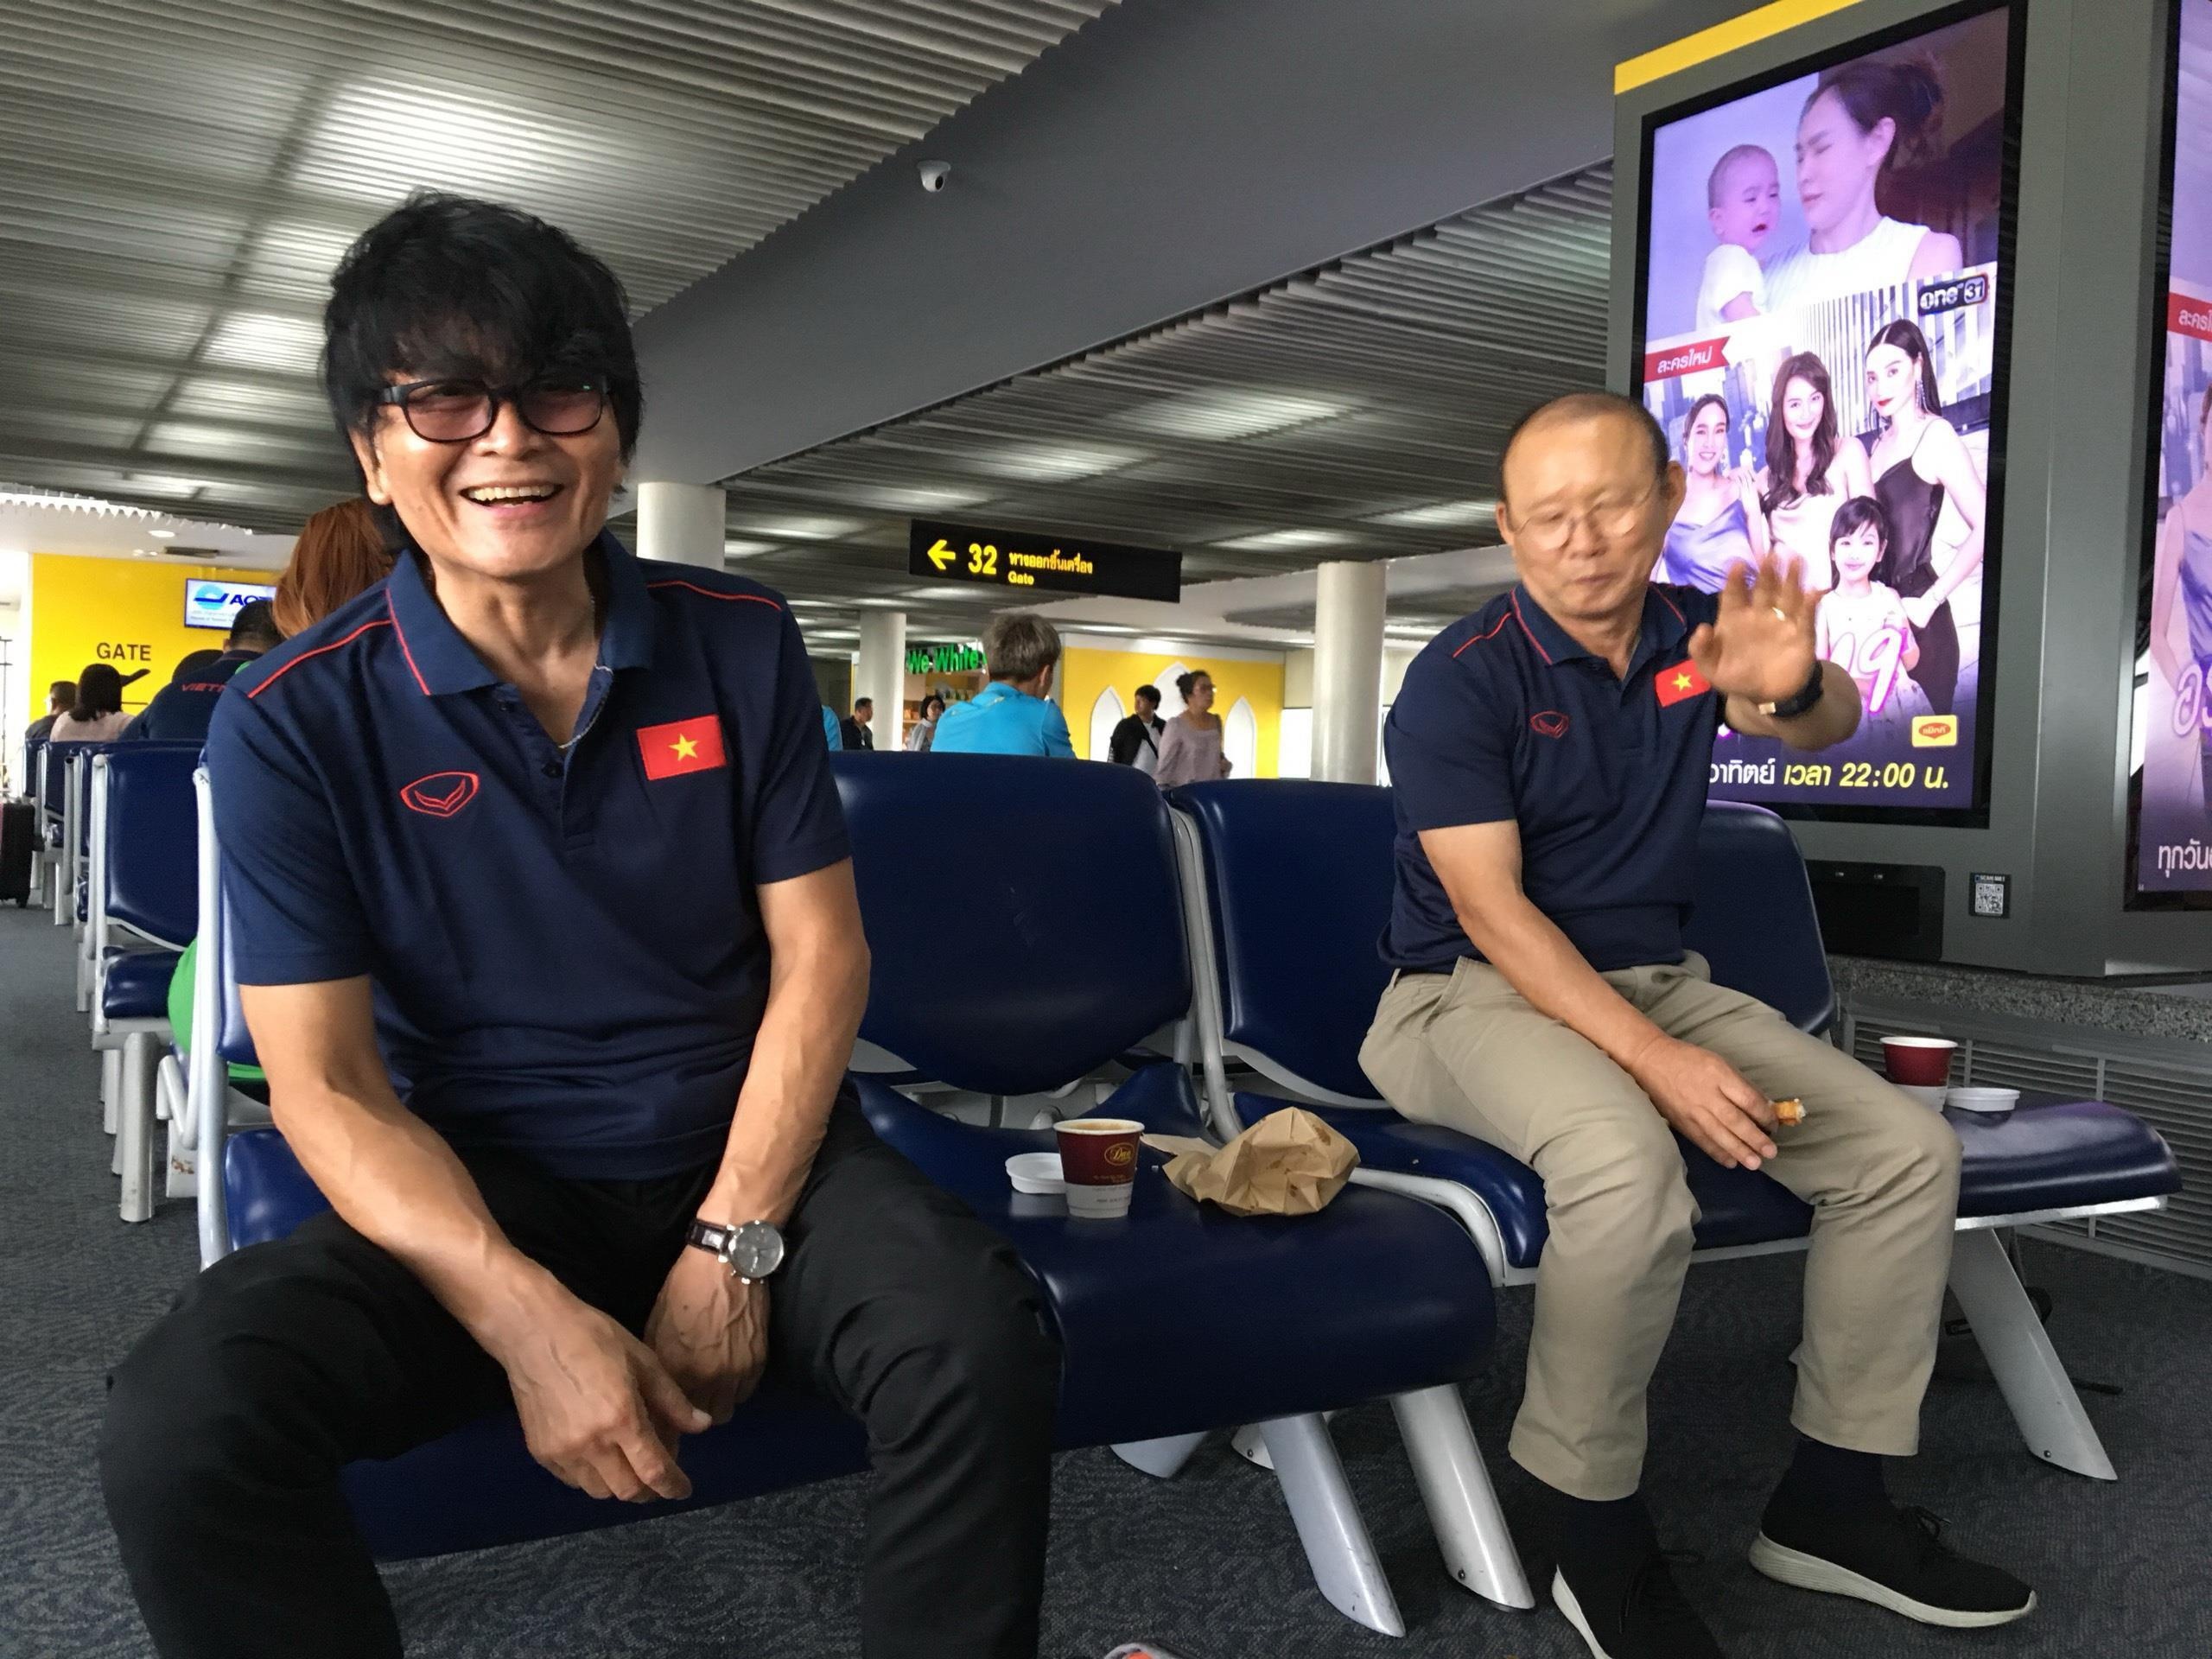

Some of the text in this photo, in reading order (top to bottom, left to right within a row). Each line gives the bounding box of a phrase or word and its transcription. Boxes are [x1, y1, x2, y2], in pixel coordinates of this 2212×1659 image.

[1965, 279, 1985, 302] 31
[1657, 345, 1713, 374] ละครใหม่
[968, 543, 998, 575] 32
[1008, 549, 1093, 575] ทางออกขึ้นเครื่อง
[1007, 570, 1035, 585] Gate
[96, 642, 152, 661] GATE
[905, 643, 979, 674] We White
[1783, 764, 1832, 785] เวลา
[1839, 762, 1916, 787] 22:00
[1923, 766, 1948, 789] น.
[2158, 837, 2212, 879] ทุกวัน
